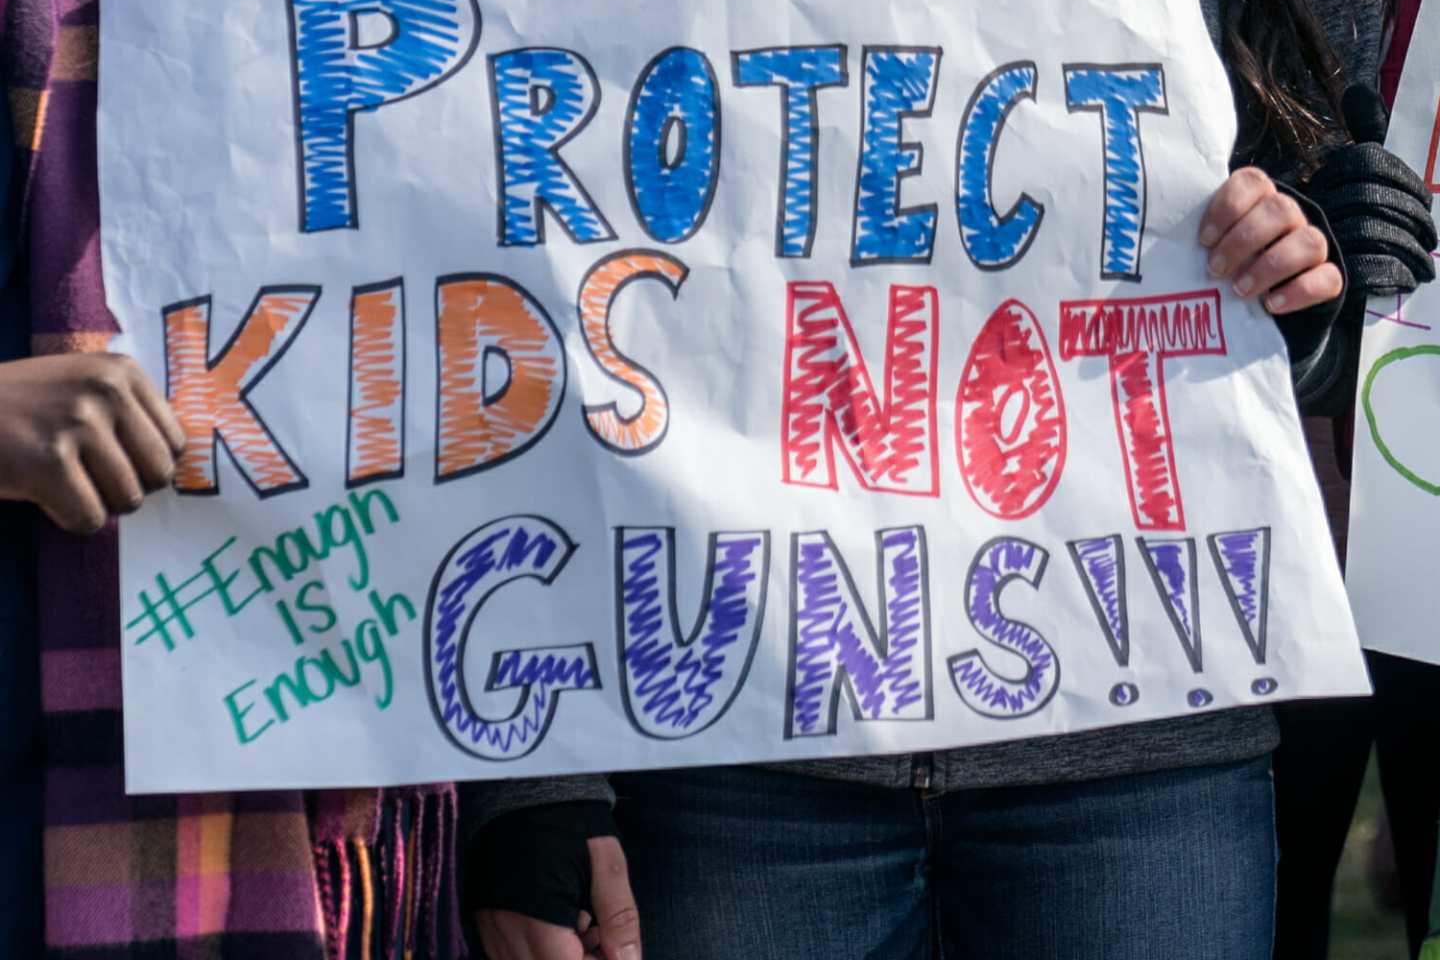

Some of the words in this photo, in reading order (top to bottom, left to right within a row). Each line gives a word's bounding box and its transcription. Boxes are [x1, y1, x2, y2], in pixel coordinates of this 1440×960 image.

[162, 247, 691, 500] KIDS
[780, 280, 1228, 531] NOT
[126, 488, 401, 653] #Enough
[223, 589, 417, 745] Enough
[422, 513, 1279, 762] GUNS!!!
